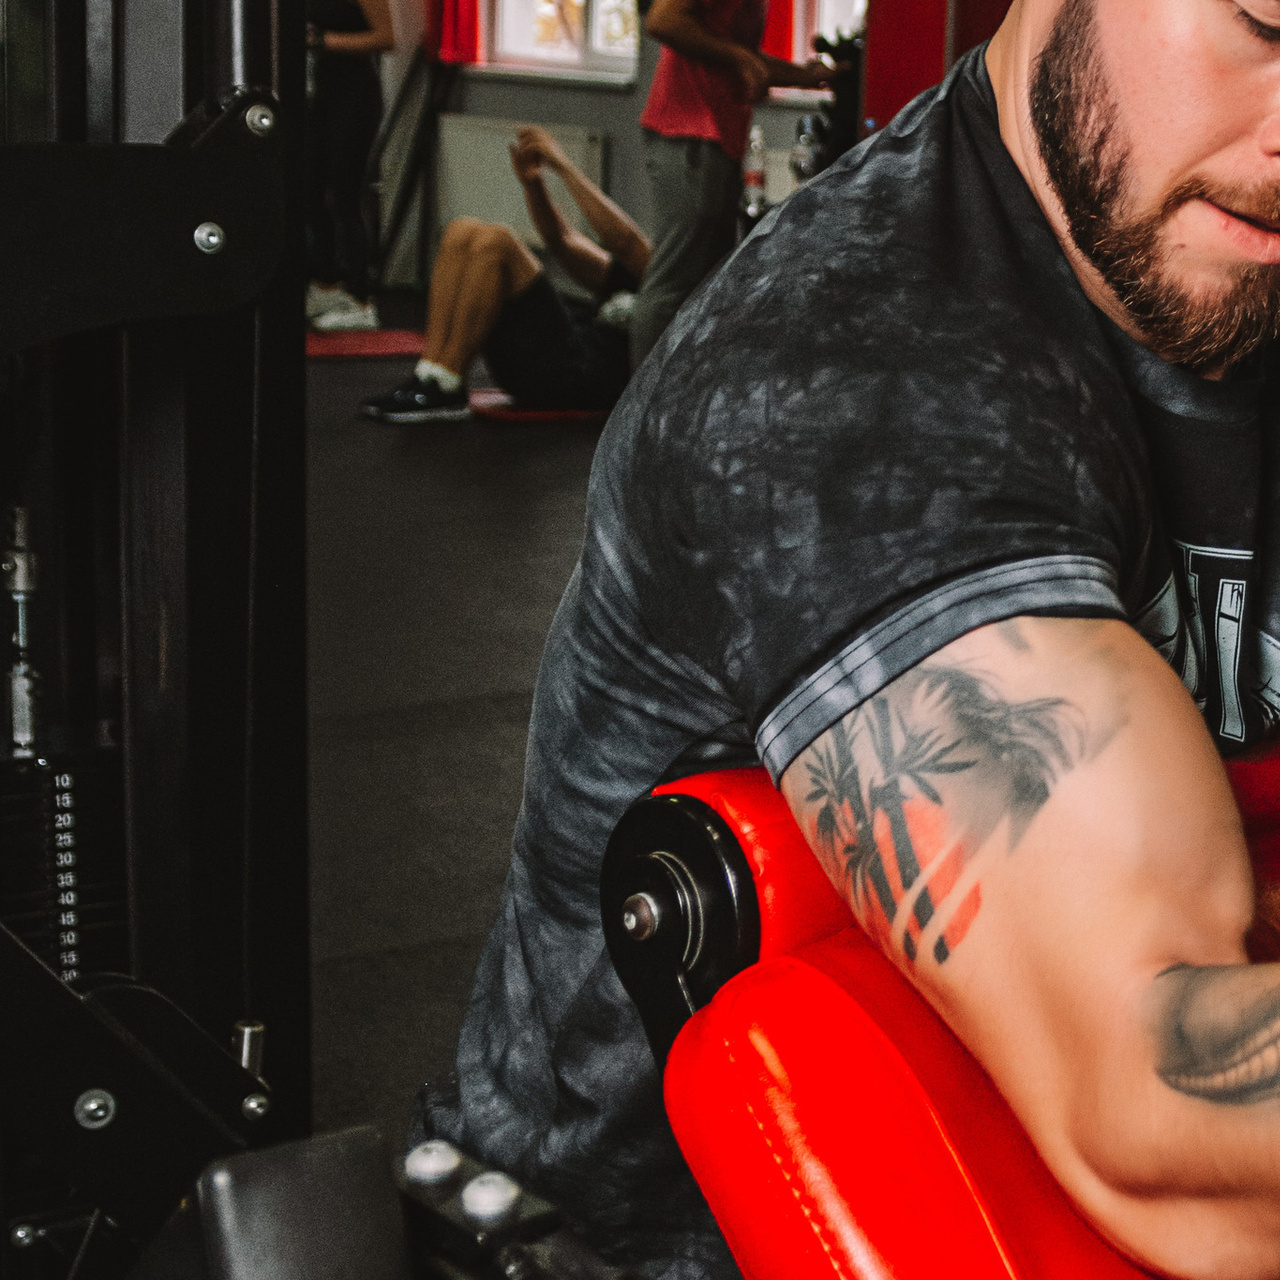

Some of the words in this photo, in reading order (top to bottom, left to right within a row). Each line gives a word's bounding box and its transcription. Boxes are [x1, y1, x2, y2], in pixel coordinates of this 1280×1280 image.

[54, 774, 74, 788] 10
[55, 793, 74, 808] 15
[54, 813, 75, 828] 20
[55, 832, 75, 847] 25
[56, 851, 76, 867] 30
[56, 871, 77, 887] 35
[58, 891, 78, 906] 40
[59, 910, 78, 926] 45
[59, 930, 79, 945] 50
[60, 949, 79, 965] 55
